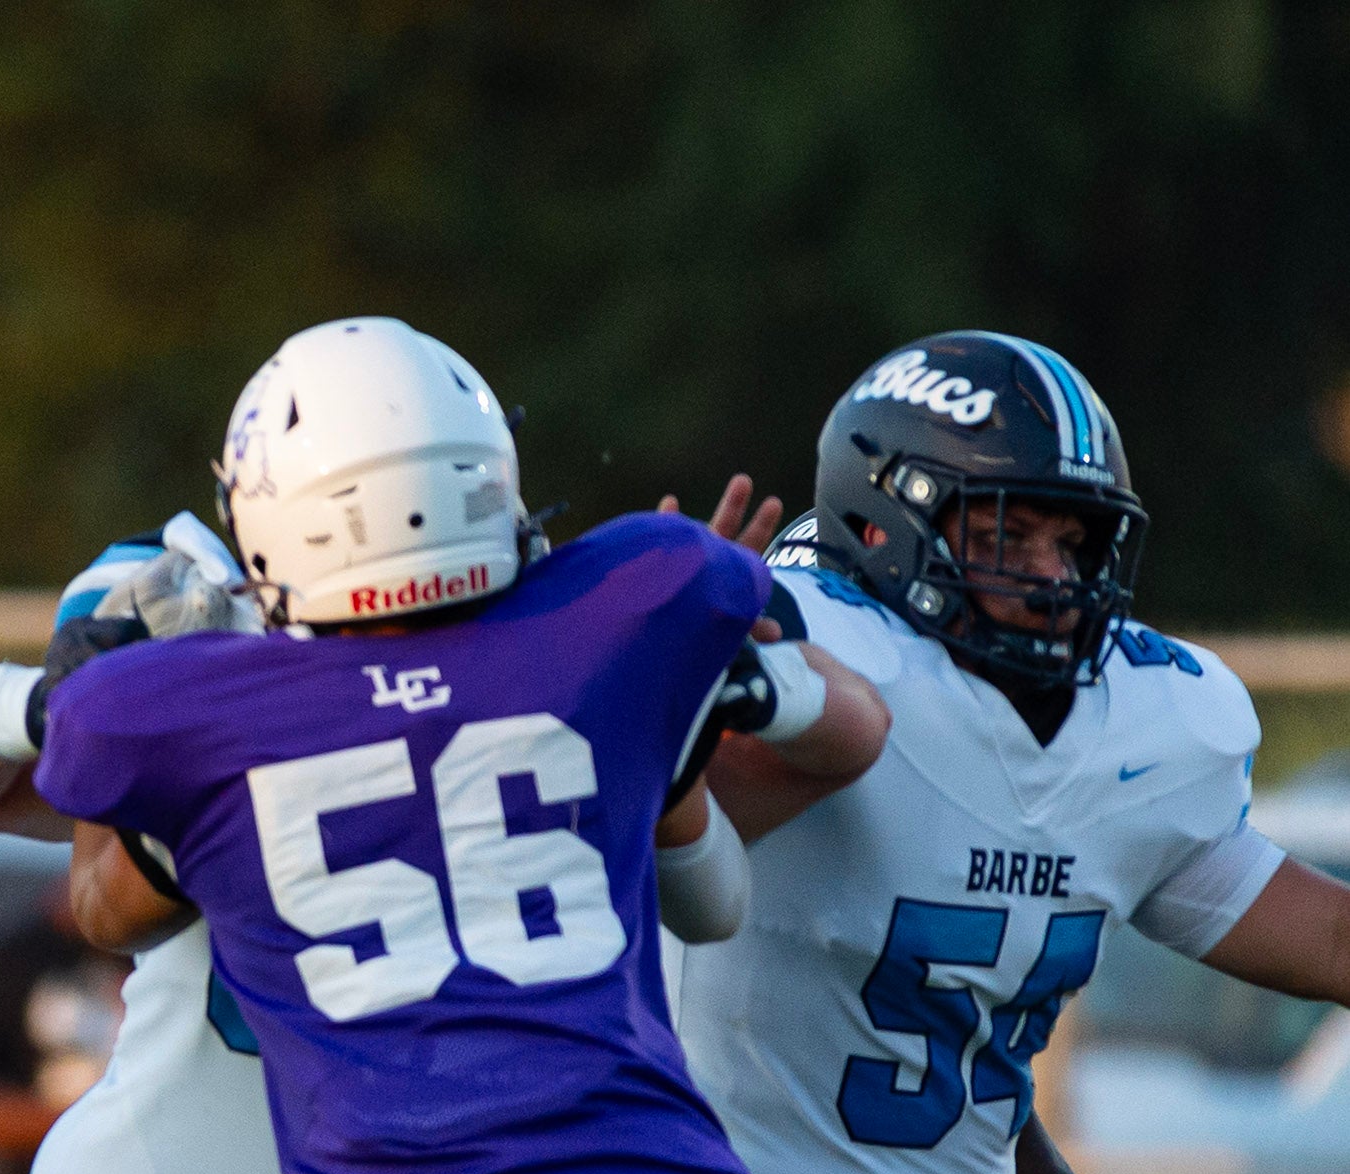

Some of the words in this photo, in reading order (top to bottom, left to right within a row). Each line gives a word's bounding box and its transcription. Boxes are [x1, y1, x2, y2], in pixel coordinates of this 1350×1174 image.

[853, 349, 998, 425] Bucs
[350, 565, 489, 614] Riddell
[361, 664, 452, 713] LC
[247, 713, 627, 1022] 56
[967, 848, 1076, 898] BARBE
[836, 896, 1108, 1150] 54
